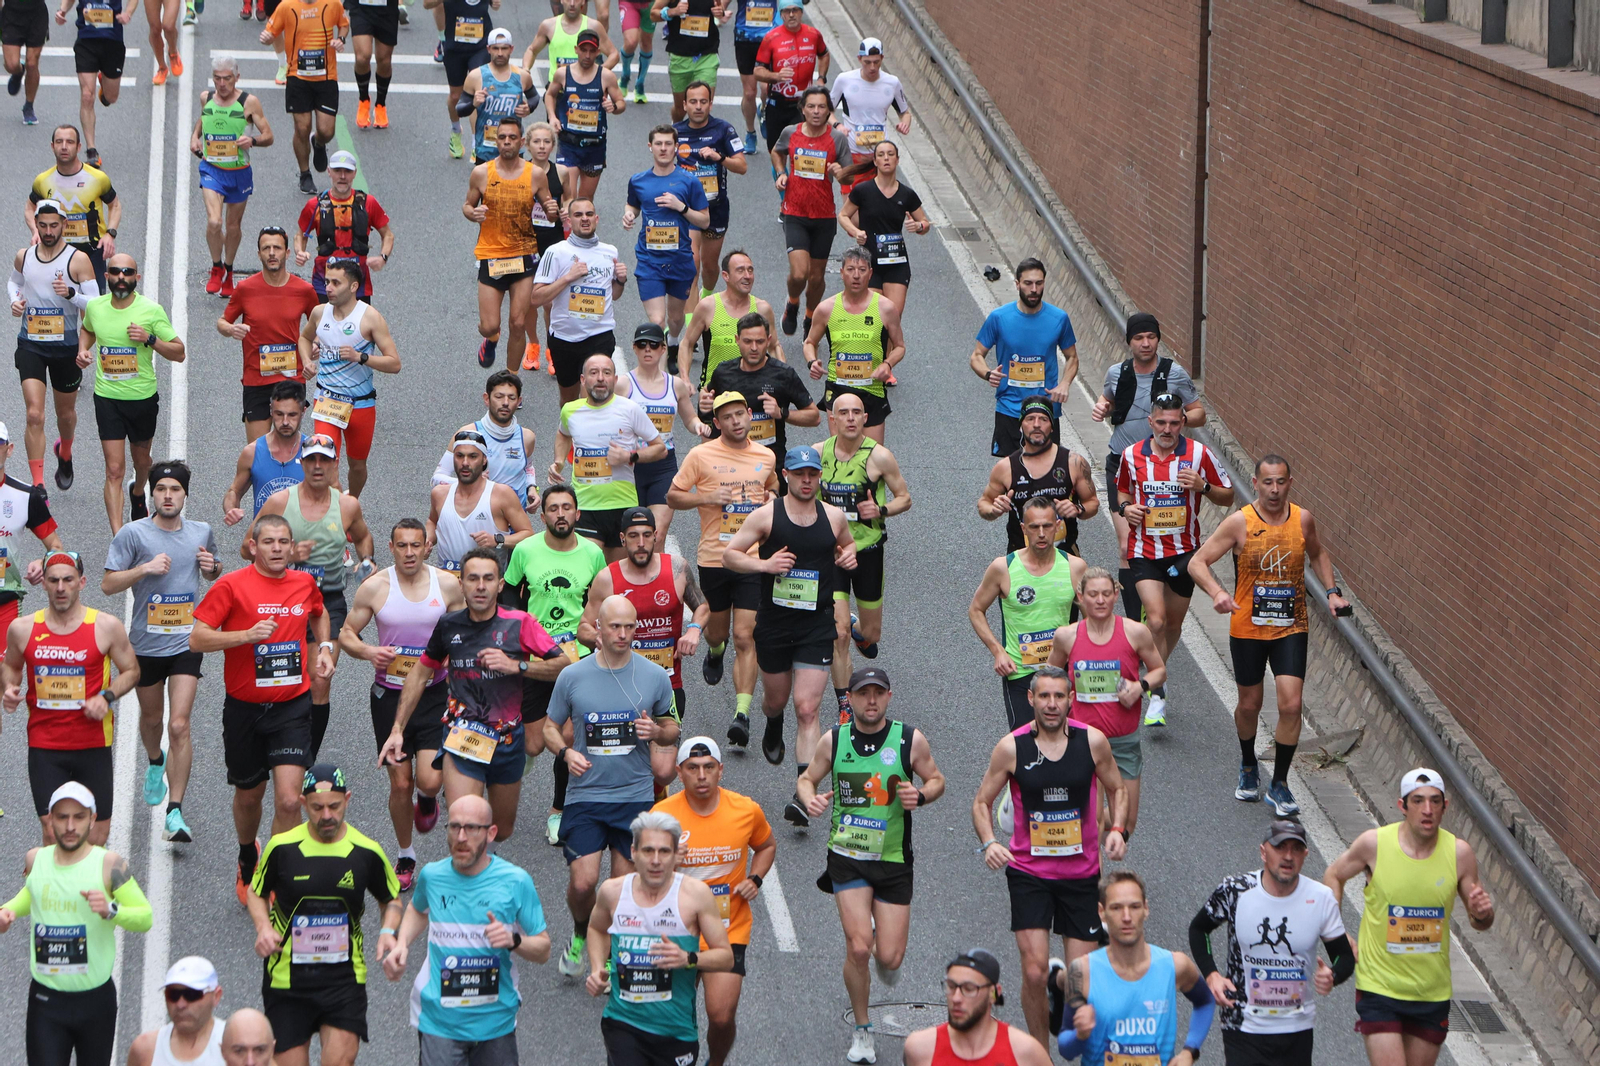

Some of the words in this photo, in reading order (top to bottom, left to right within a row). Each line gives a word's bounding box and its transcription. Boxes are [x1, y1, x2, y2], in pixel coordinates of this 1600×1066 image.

[333, 393, 353, 402] ZURICH
[1014, 491, 1027, 500] LOS
[1035, 632, 1055, 640] ZURIC
[271, 644, 296, 652] ZURICH
[35, 650, 74, 659] OZONO
[466, 659, 474, 667] DE
[470, 723, 495, 737] ZURICH
[602, 728, 619, 736] 2285
[460, 745, 477, 755] PEDRO
[839, 780, 850, 788] Na
[840, 788, 852, 796] tur
[854, 819, 881, 829] ZURICH
[851, 833, 868, 841] 1843
[683, 856, 719, 865] ALENCIA
[1408, 908, 1438, 917] ZURICH
[312, 917, 343, 925] ZURICH
[653, 919, 677, 927] LaMafia
[48, 928, 80, 936] ZURICH
[461, 958, 493, 967] ZURICH
[633, 971, 652, 981] 3443
[1270, 971, 1301, 980] ZURICH
[462, 988, 479, 996] JUAN
[1269, 987, 1288, 995] 7142
[1115, 1017, 1156, 1036] DUXO
[1124, 1045, 1156, 1054] ZURICH
